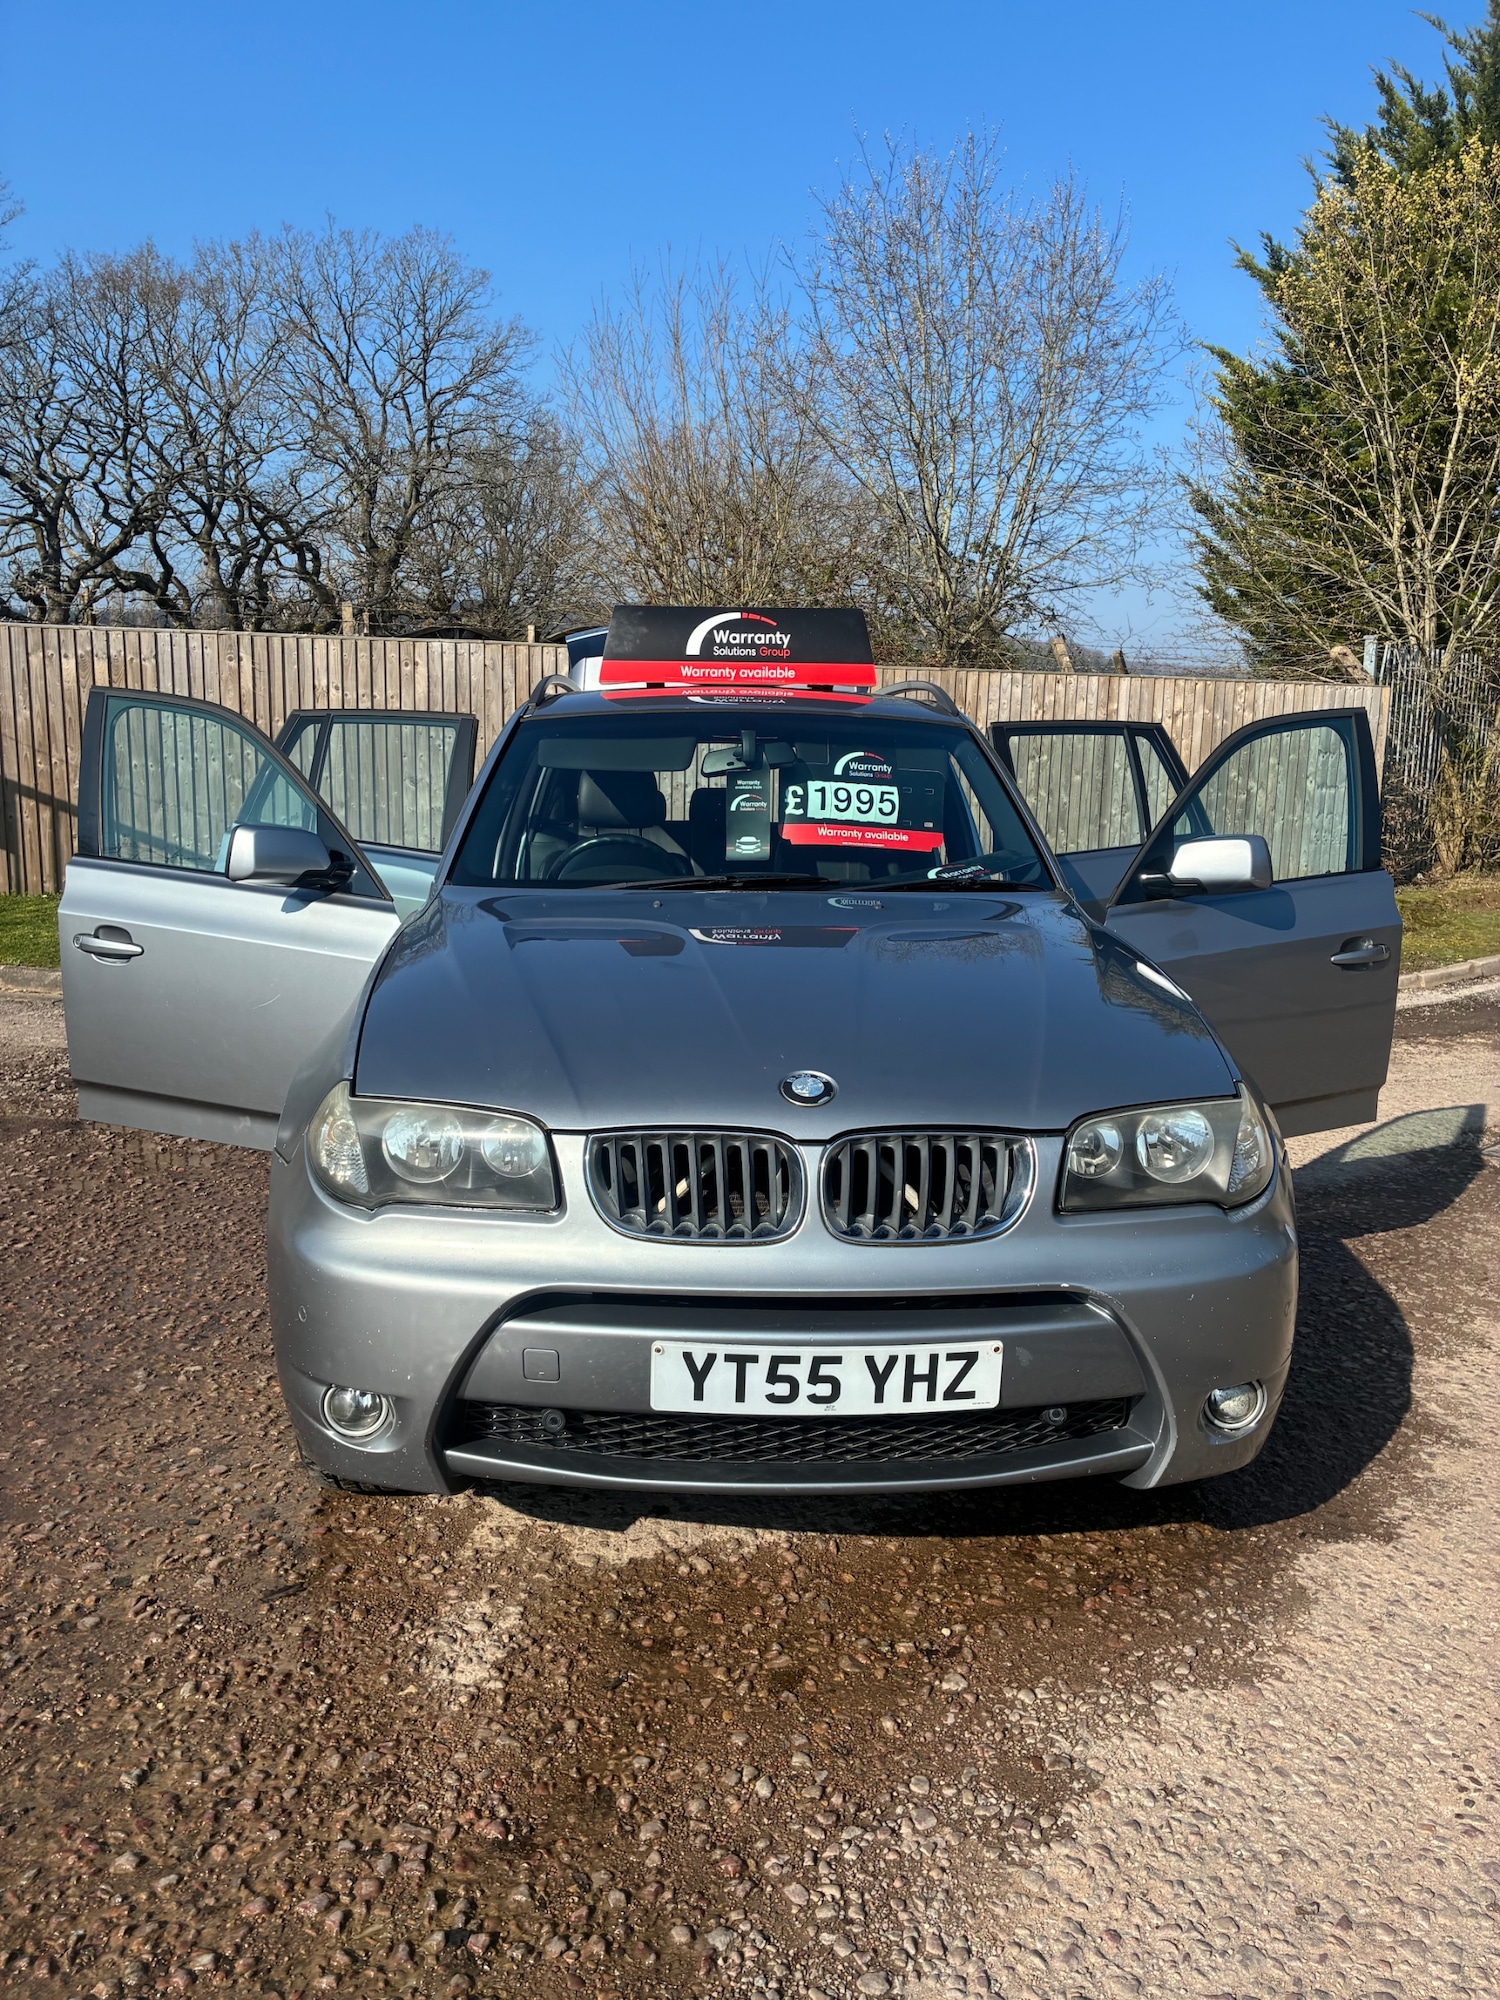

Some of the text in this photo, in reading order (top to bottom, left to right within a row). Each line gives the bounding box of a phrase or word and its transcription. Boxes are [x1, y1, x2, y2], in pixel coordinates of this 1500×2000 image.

[713, 629, 791, 650] Warranty
[713, 646, 791, 659] Solutions Group
[680, 666, 796, 681] Warranty available
[849, 761, 892, 774] Warranty
[849, 770, 873, 778] Solutions
[817, 827, 909, 842] Warranty available
[682, 1351, 979, 1405] YT55 YHZ
